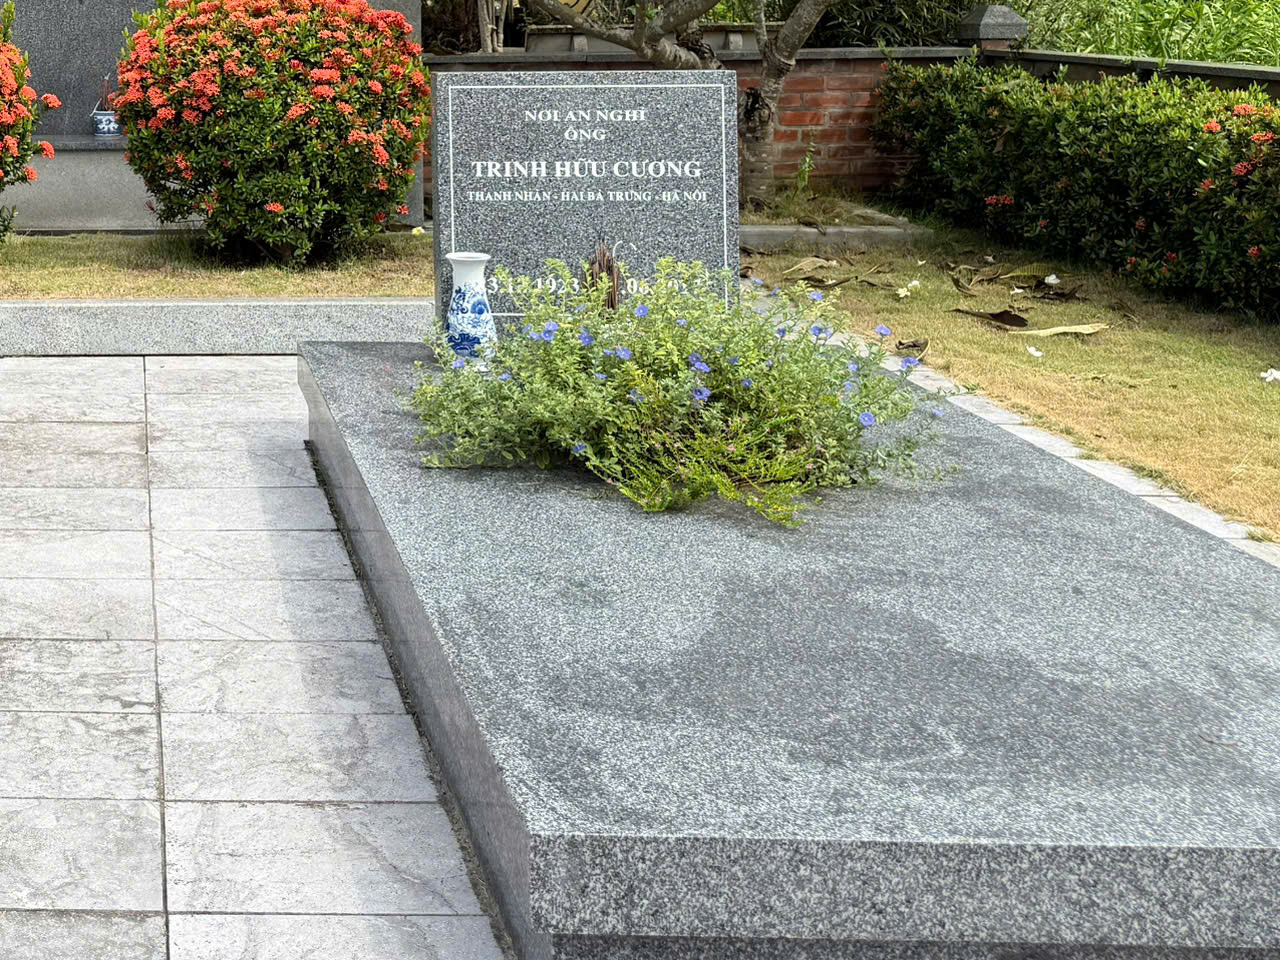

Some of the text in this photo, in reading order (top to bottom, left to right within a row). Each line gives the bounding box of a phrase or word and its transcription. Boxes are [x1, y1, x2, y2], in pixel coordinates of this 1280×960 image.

[525, 109, 561, 121] NƠI
[565, 110, 590, 121] AN
[564, 126, 606, 141] ÔNG
[471, 160, 548, 182] TRỊNH
[554, 158, 608, 178] HỮU
[468, 191, 512, 201] THANH
[561, 191, 587, 201] HAI
[587, 189, 604, 201] BÀ
[607, 189, 652, 201] TRƯNG
[683, 189, 708, 202] NỘI
